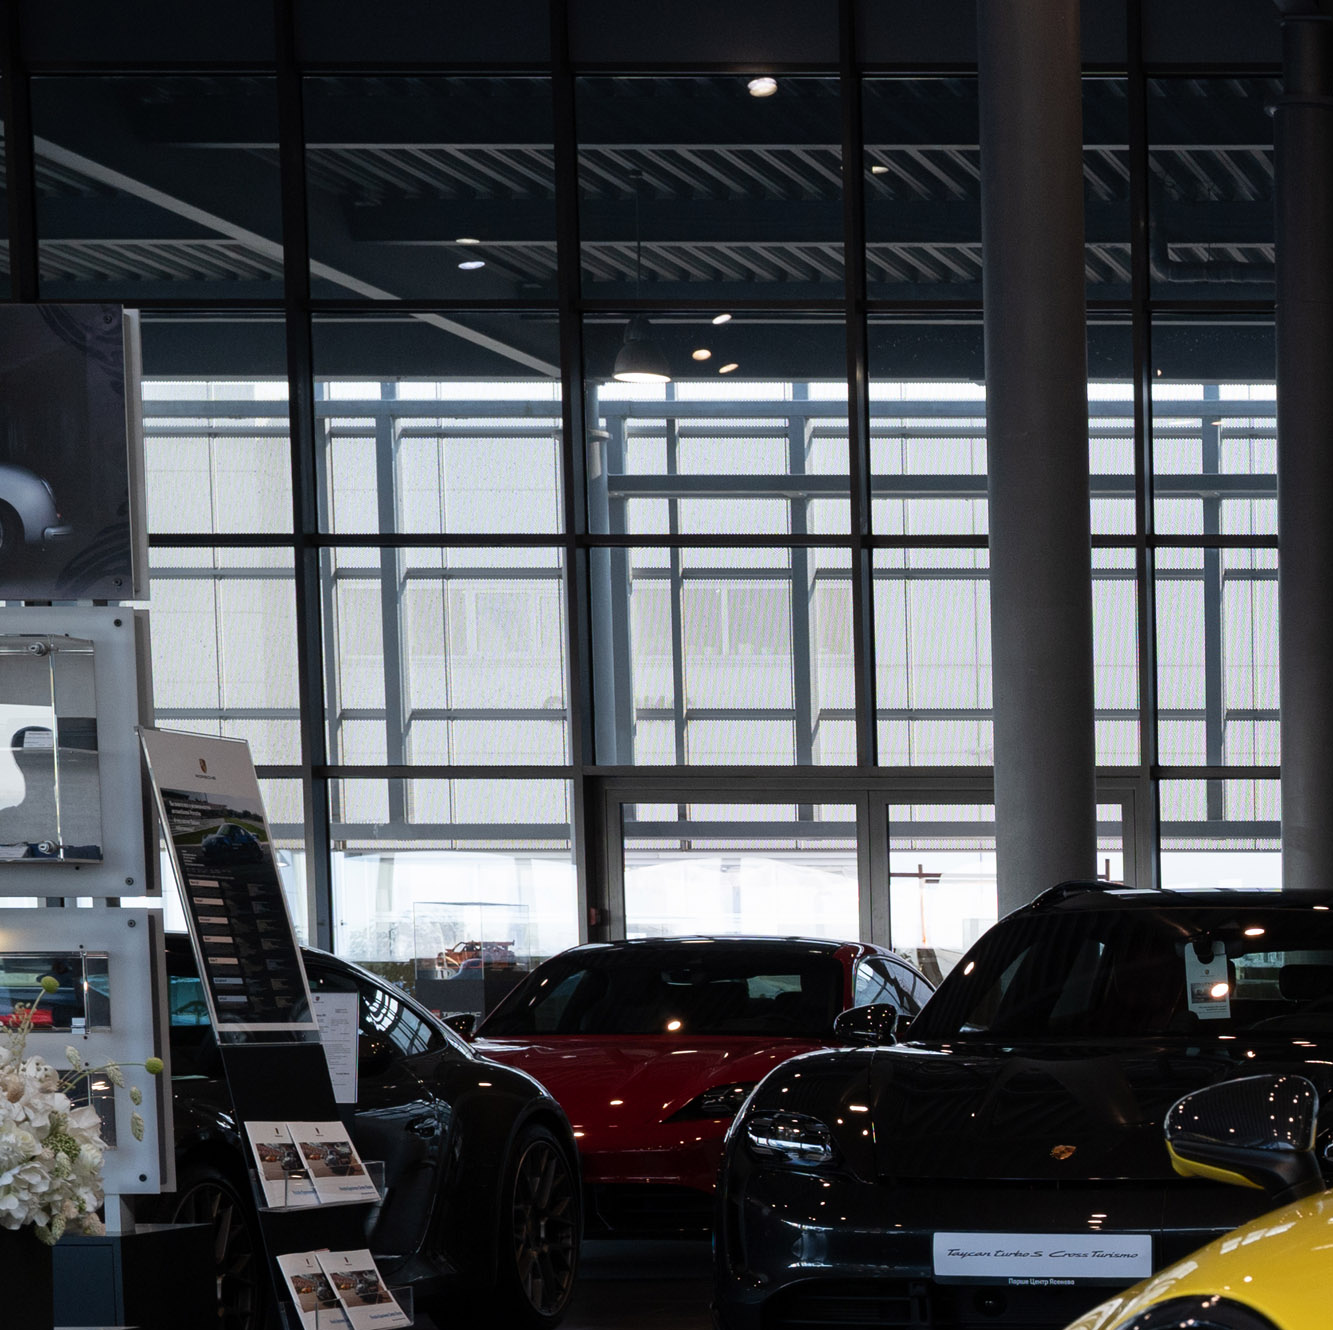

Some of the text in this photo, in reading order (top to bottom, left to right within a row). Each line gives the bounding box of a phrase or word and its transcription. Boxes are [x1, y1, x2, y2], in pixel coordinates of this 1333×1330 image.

[946, 1248, 991, 1259] Taycan
[993, 1249, 1030, 1257] turbo
[1048, 1250, 1089, 1258] Cross
[1091, 1250, 1139, 1258] Turismo
[1008, 1277, 1076, 1286] Порше Центр Ясенево
